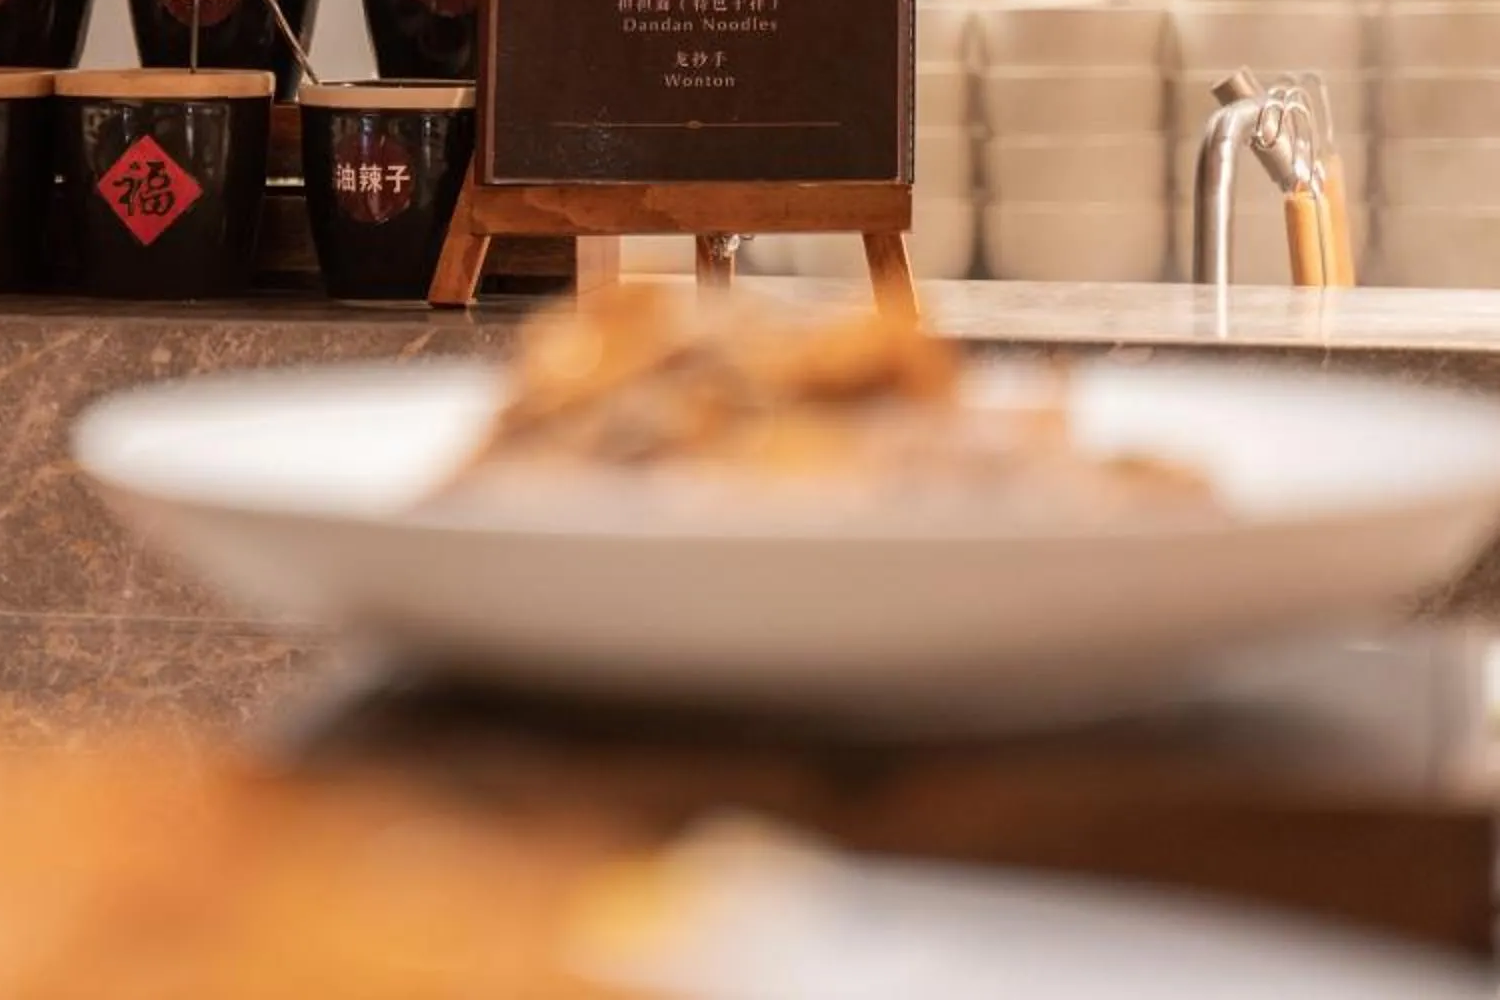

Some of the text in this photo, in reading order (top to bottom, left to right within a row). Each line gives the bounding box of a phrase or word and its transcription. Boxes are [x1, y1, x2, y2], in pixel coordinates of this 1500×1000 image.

[623, 16, 778, 32] Dandan Noodles
[664, 73, 736, 88] Wonton
[112, 160, 176, 217] 福
[336, 161, 411, 194] 油辣子
